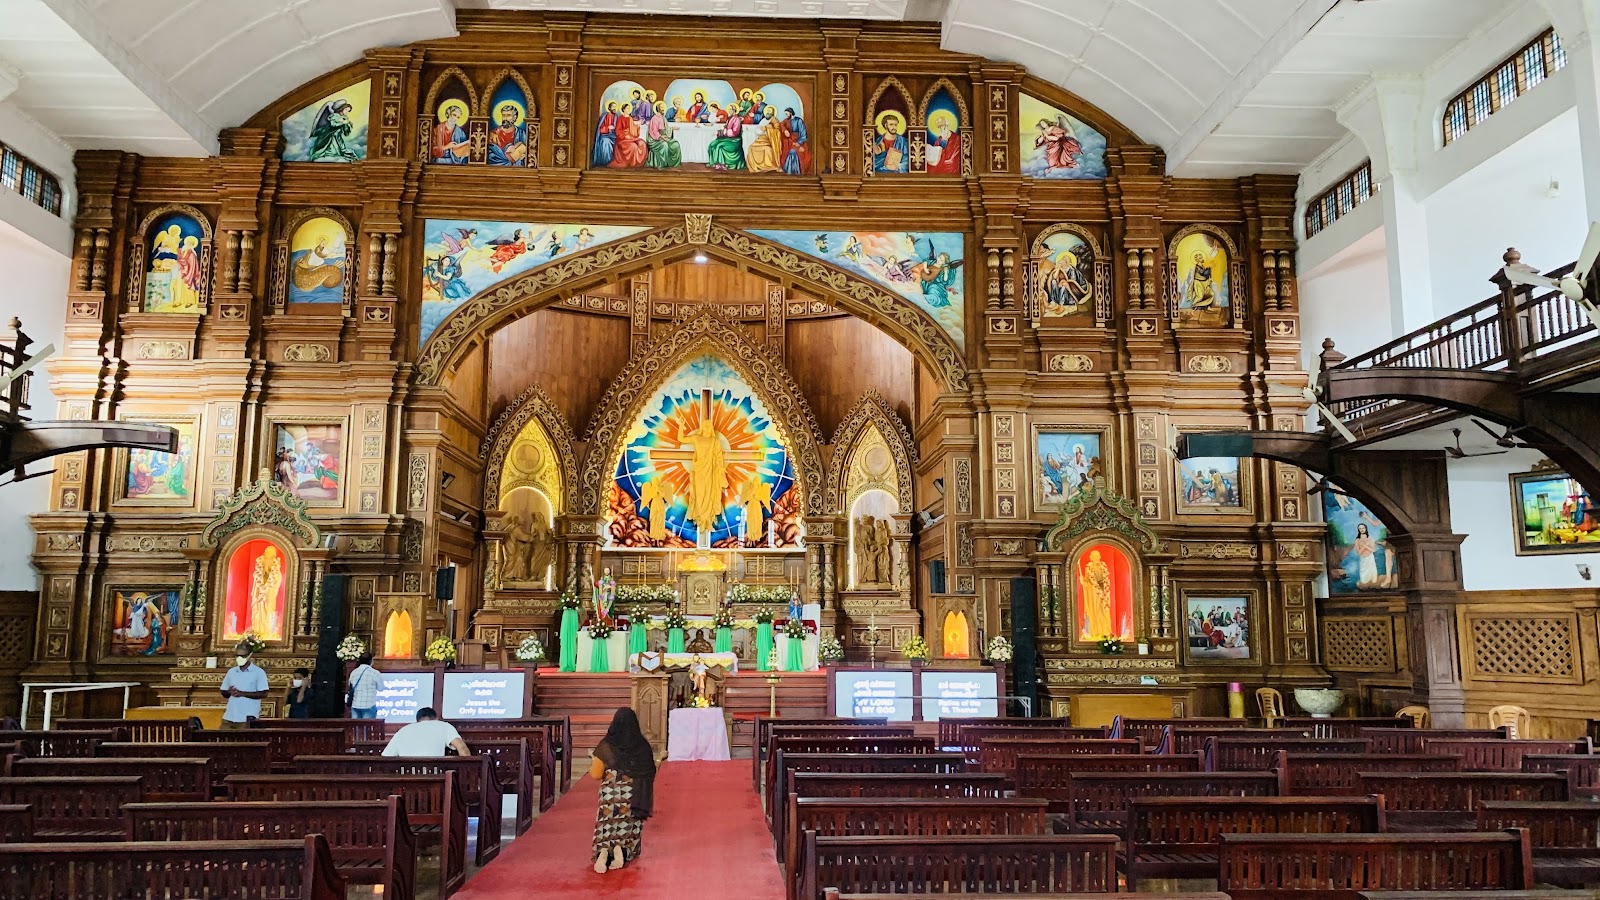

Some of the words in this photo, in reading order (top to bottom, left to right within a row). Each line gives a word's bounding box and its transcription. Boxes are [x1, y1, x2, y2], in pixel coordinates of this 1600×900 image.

[377, 708, 389, 717] oly
[459, 707, 476, 715] Only
[862, 706, 875, 714] MY
[876, 706, 895, 714] GOD
